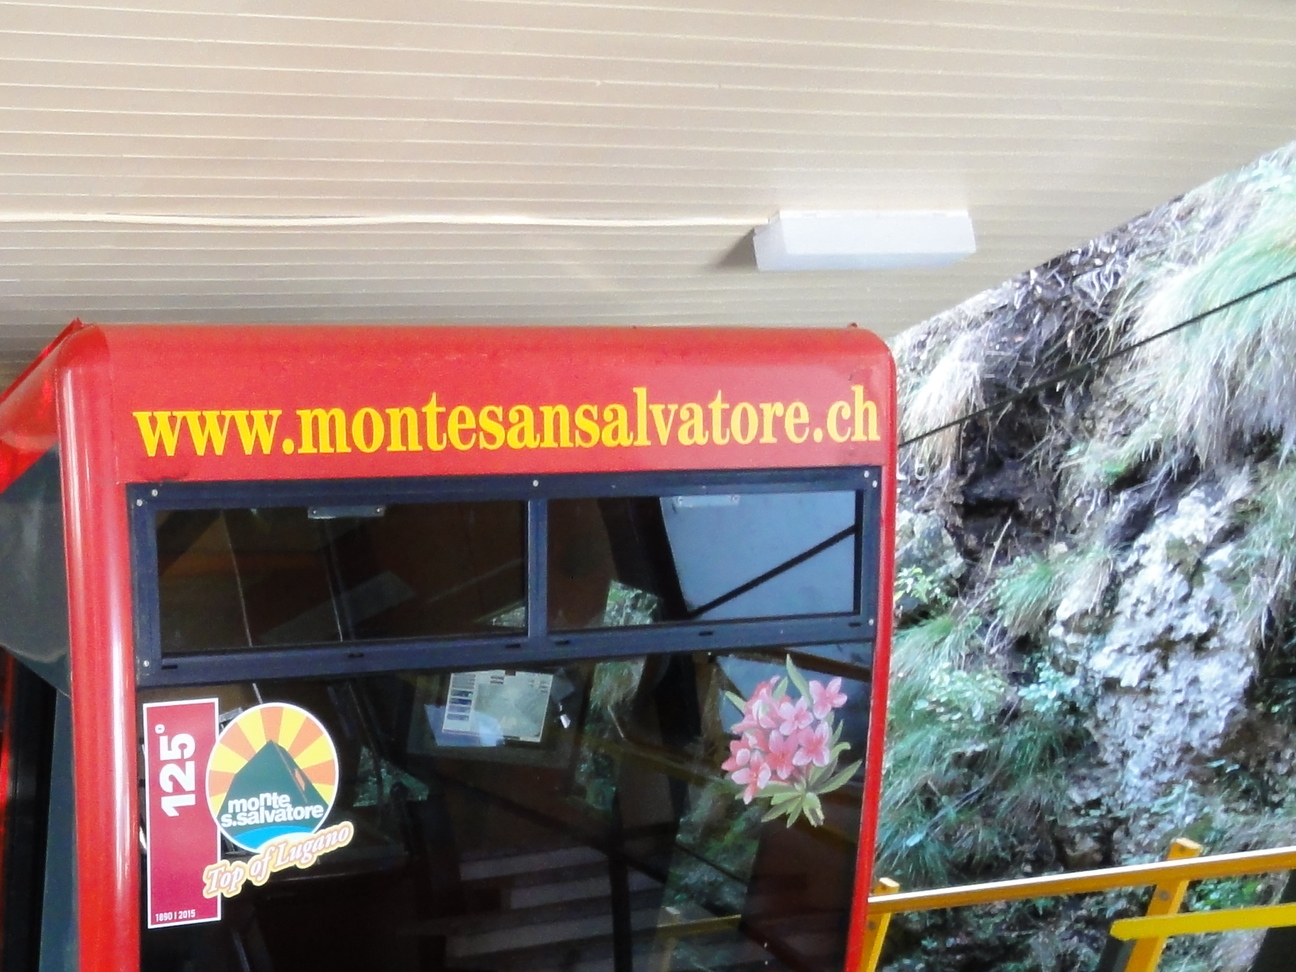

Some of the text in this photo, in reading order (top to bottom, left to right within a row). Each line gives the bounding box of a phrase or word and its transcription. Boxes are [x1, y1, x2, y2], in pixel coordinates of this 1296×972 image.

[133, 385, 881, 457] www.montesansalvatore.ch
[227, 792, 291, 814] monte
[220, 804, 324, 828] s.salvatore
[207, 826, 350, 893] Top of Lugano
[178, 909, 196, 919] 2015
